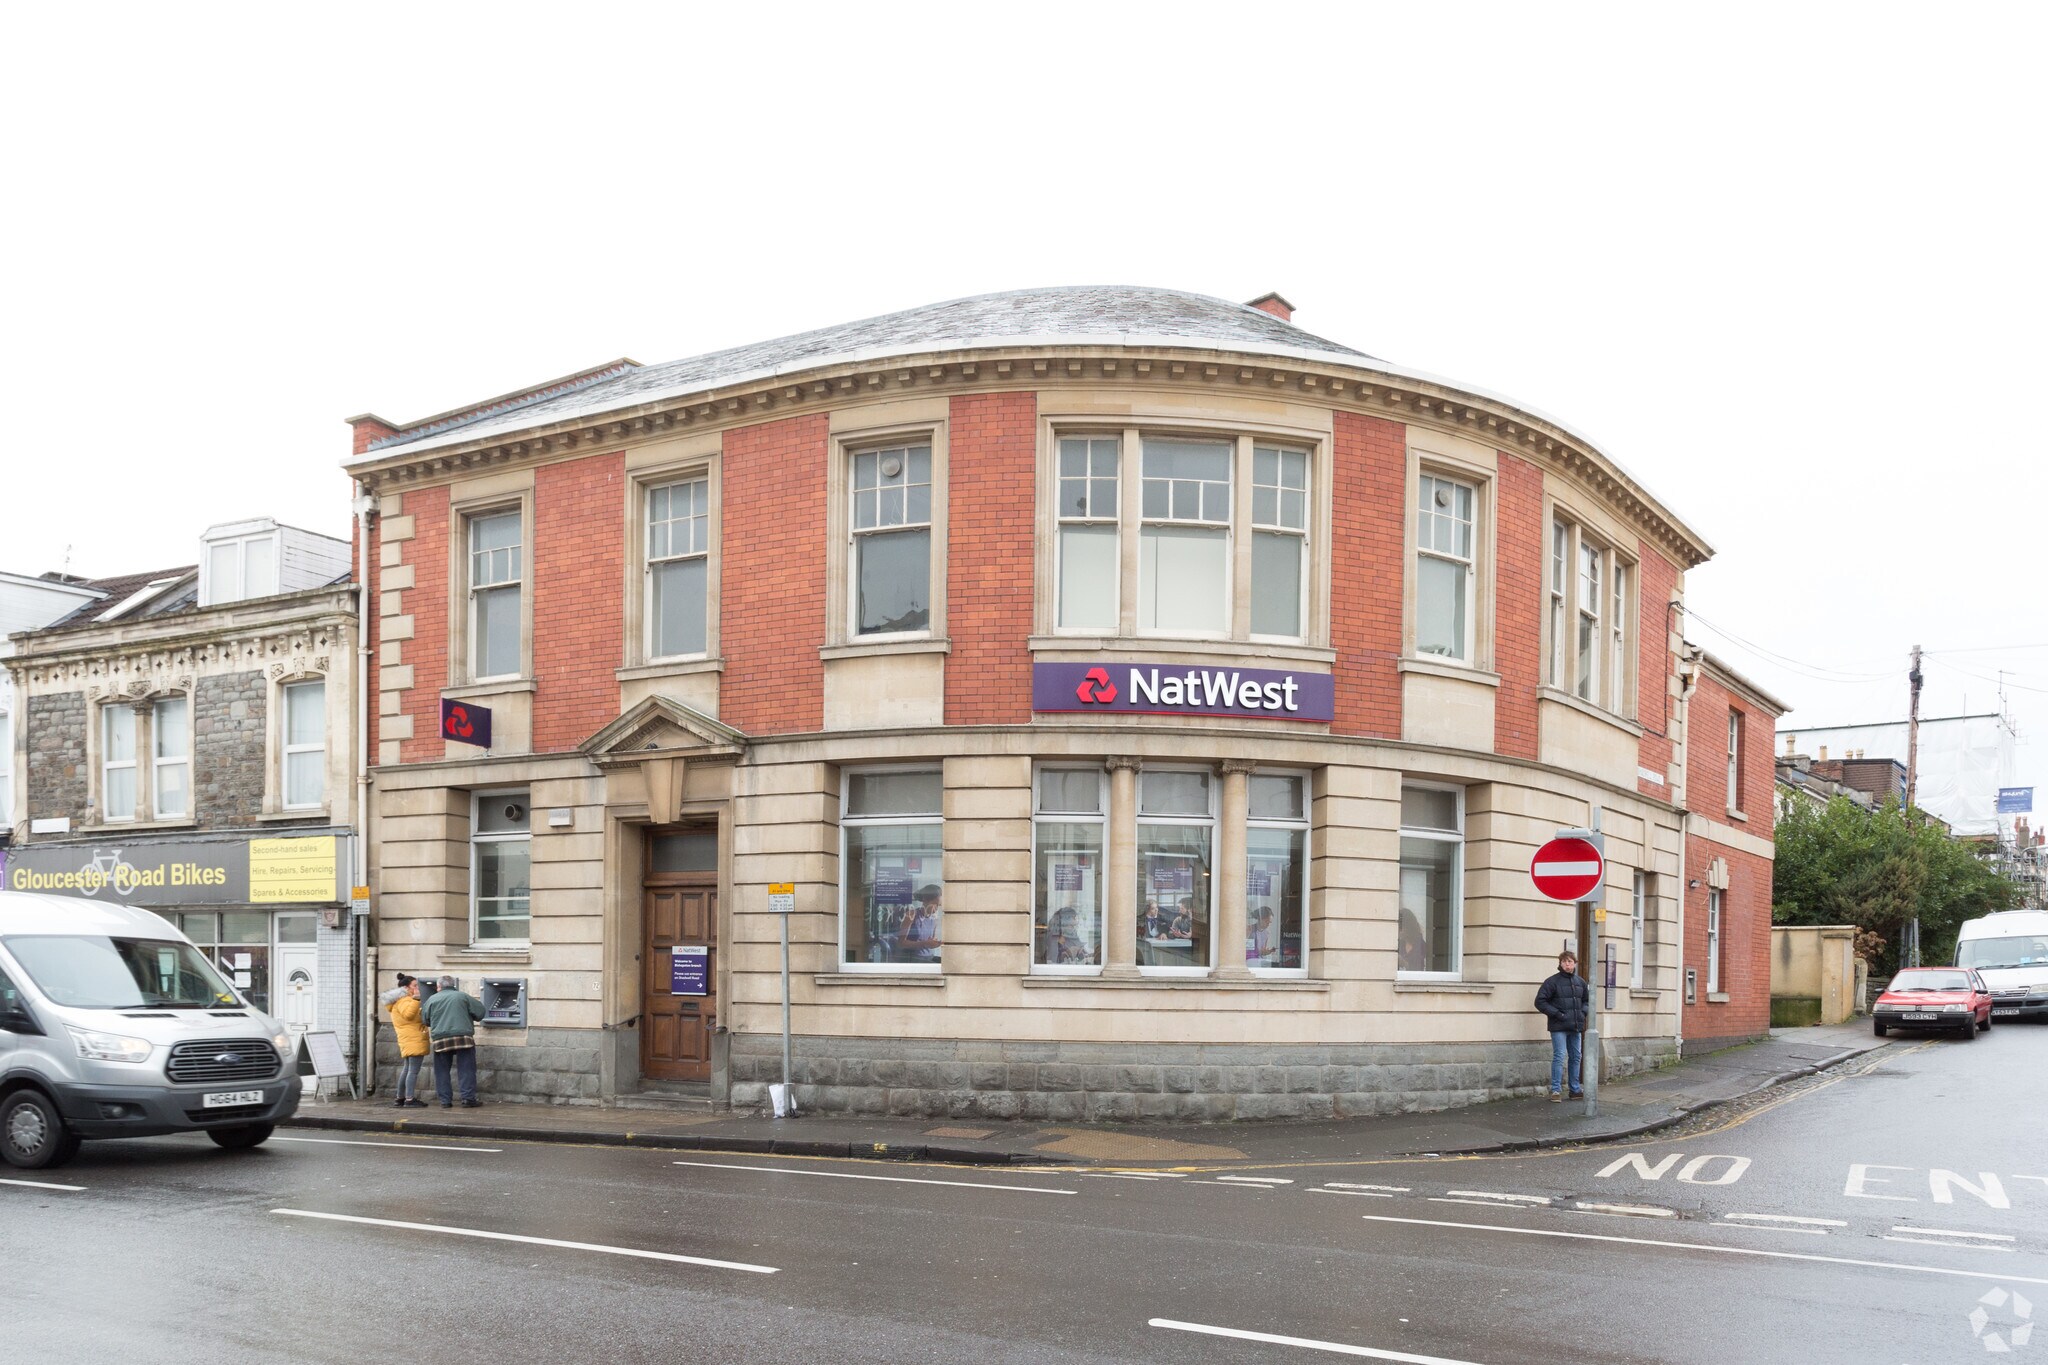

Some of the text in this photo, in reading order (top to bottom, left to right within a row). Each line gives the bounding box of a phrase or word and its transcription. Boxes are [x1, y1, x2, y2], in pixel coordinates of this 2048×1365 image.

[1130, 668, 1298, 711] NatWest
[252, 844, 318, 854] Second-hand sales
[13, 863, 226, 890] Gloucester Road Bikes
[252, 888, 328, 897] Spares & Accessories
[1594, 1153, 1752, 1185] NO
